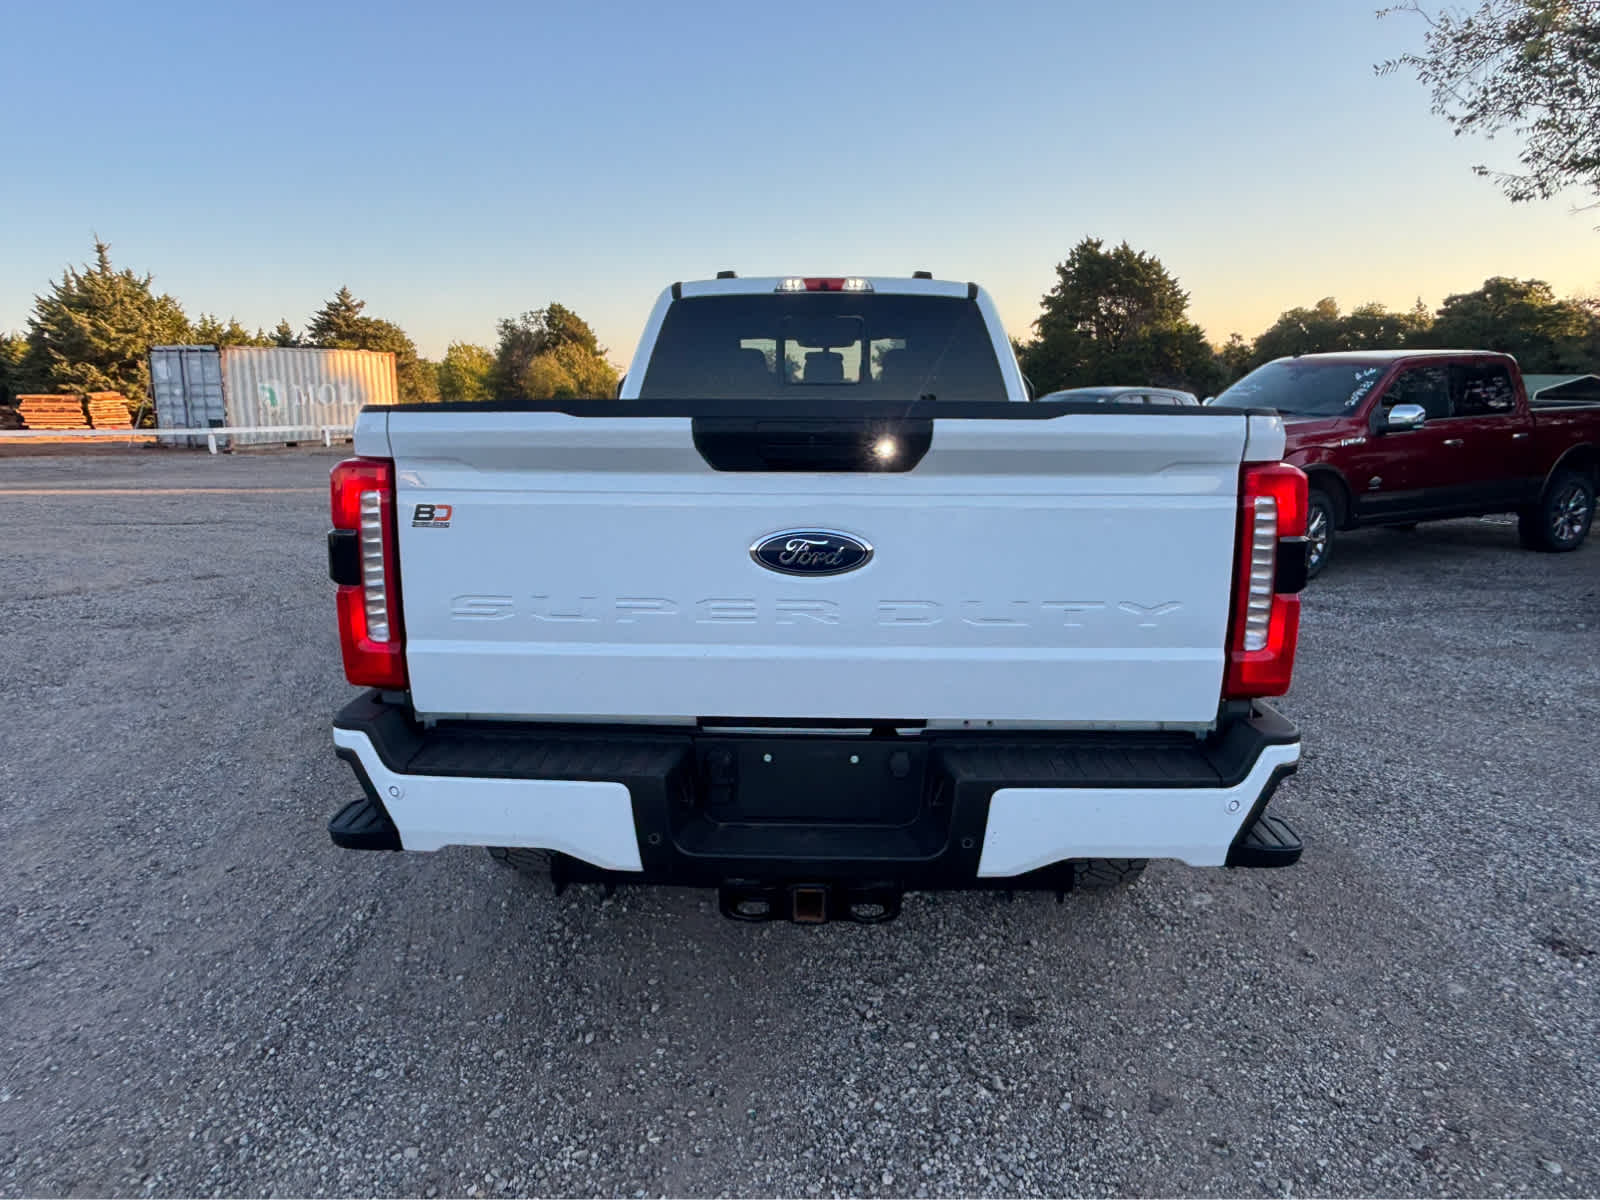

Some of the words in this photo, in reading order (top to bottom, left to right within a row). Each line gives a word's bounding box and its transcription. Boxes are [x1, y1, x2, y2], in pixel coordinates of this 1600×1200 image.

[778, 538, 845, 566] Ford
[452, 594, 840, 625] SUPER
[878, 599, 1183, 628] DUTY
